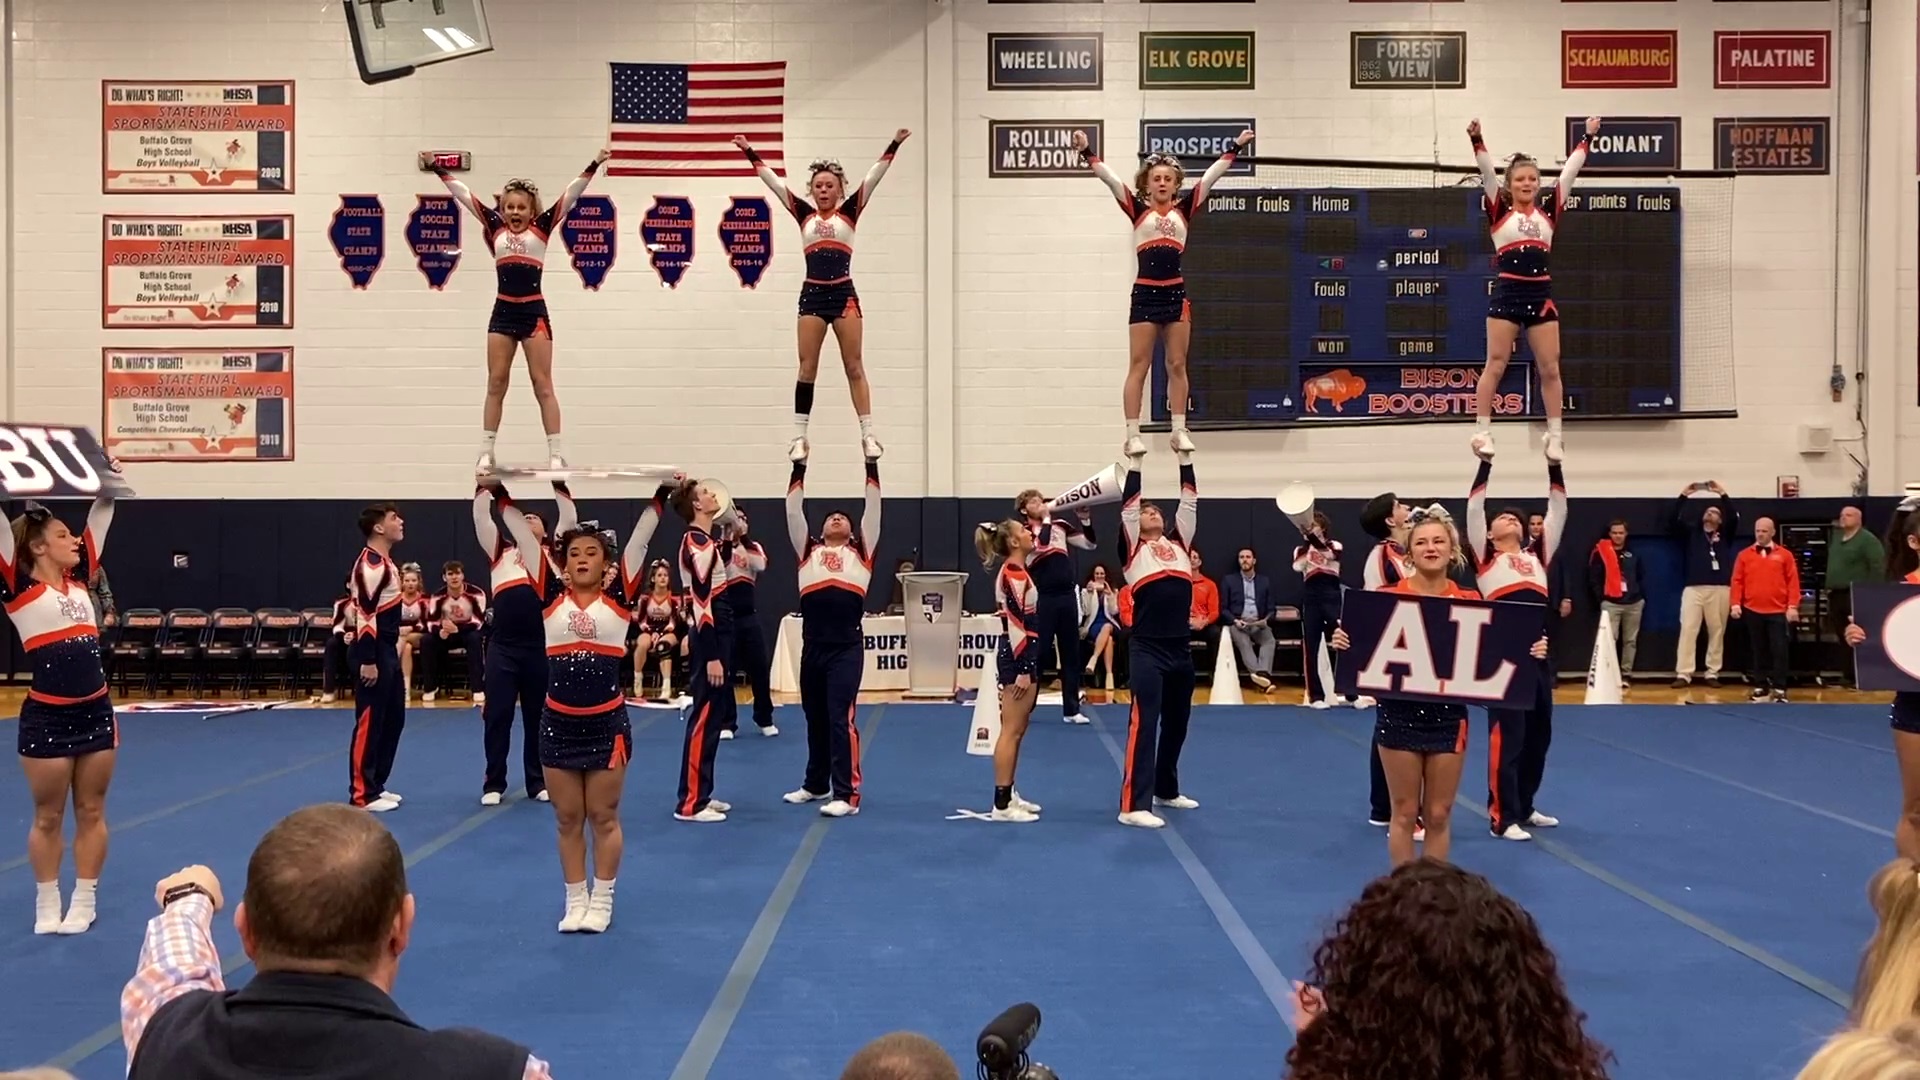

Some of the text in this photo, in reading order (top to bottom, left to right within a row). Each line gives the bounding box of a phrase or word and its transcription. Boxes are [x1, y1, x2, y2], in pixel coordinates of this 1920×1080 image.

[1376, 41, 1445, 59] FOREST
[1000, 51, 1092, 70] WHEELING
[1149, 49, 1246, 69] ELK GROVE
[1569, 49, 1671, 67] SCHAUMBURG
[1731, 49, 1815, 67] PALATINE
[1359, 60, 1381, 70] 1962
[1387, 61, 1433, 78] VIEW
[1359, 70, 1381, 80] 1986
[159, 106, 239, 117] STATE FINAL
[113, 118, 286, 130] SPORTSMANSHIP AWARD
[139, 135, 193, 145] Buffalo Grove
[1009, 129, 1073, 148] ROLLIN
[1729, 127, 1814, 145] HOFFMAN
[1589, 135, 1663, 153] CONANT
[143, 147, 192, 158] High School
[1733, 148, 1812, 166] ESTATES
[136, 158, 201, 168] Boys Volleyball
[1208, 195, 1290, 213] points fouls
[1312, 194, 1350, 212] Home
[1588, 194, 1627, 210] points
[1637, 194, 1671, 211] fouls
[343, 207, 383, 217] FOOTBALL
[420, 214, 455, 225] SOCCER
[347, 226, 372, 236] STATE
[420, 229, 451, 239] STATE
[655, 232, 682, 242] STATE
[733, 233, 760, 242] STATE
[159, 241, 238, 252] STATE FINAL
[343, 246, 378, 256] CHAMPS
[113, 253, 285, 264] SPORTSMANSHIP AWARD
[1395, 249, 1439, 267] period
[139, 271, 193, 280] Buffalo Grove
[143, 282, 192, 293] High School
[1314, 281, 1346, 297] fouls
[1395, 279, 1440, 297] player
[136, 293, 200, 303] Boys Volleyball
[260, 301, 279, 313] 2010
[1317, 340, 1344, 353] won
[1399, 341, 1434, 356] game
[158, 374, 237, 385] STATE FINAL
[113, 386, 284, 397] SPORTSMANSHIP AWARD
[132, 402, 190, 412] Buffalo Grove
[136, 413, 188, 423] High School
[117, 425, 206, 435] Competitive Cheerleading
[1055, 477, 1102, 507] BISON
[864, 635, 907, 650] BUFF
[1356, 601, 1517, 700] AL
[876, 654, 908, 670] HIG
